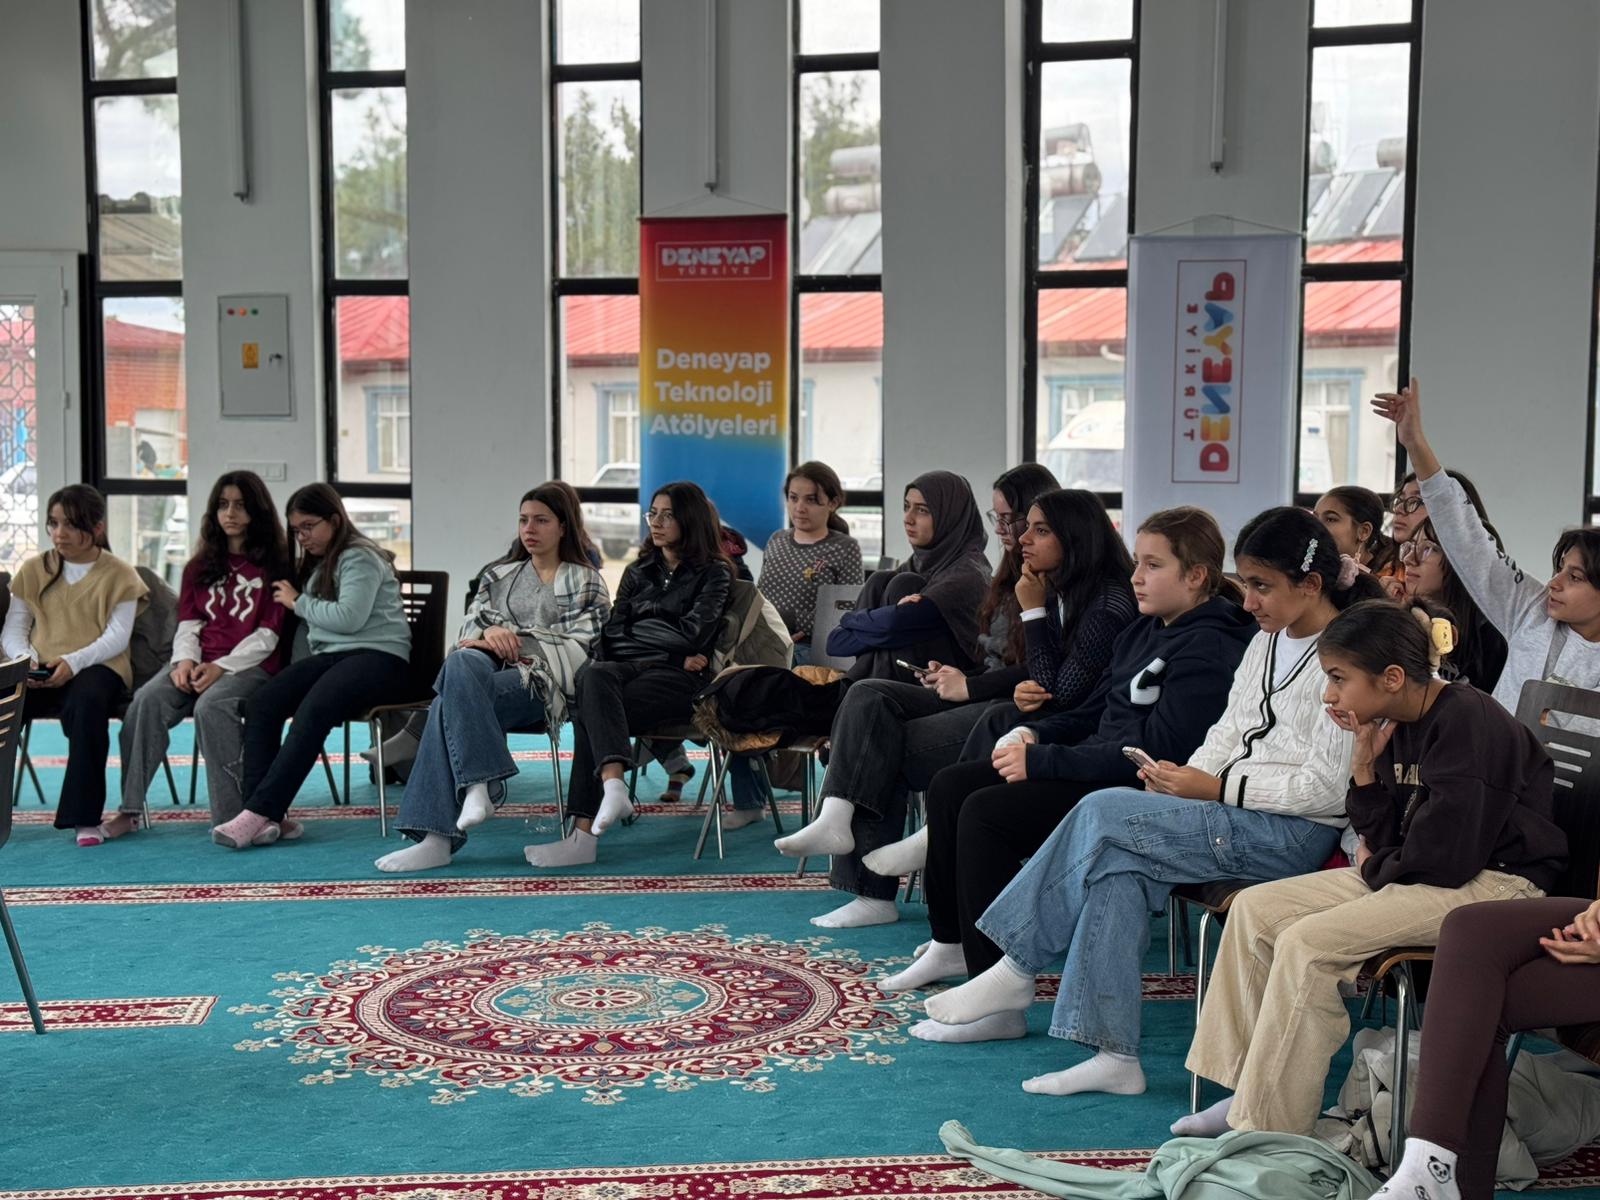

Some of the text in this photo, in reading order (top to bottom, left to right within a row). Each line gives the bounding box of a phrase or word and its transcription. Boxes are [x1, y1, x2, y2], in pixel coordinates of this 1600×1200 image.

[661, 246, 766, 267] DENEYAP
[678, 264, 750, 275] TÜRKİYE
[656, 348, 771, 374] Deneyap
[655, 380, 772, 406] Teknoloji
[649, 413, 777, 439] Atölyeleri
